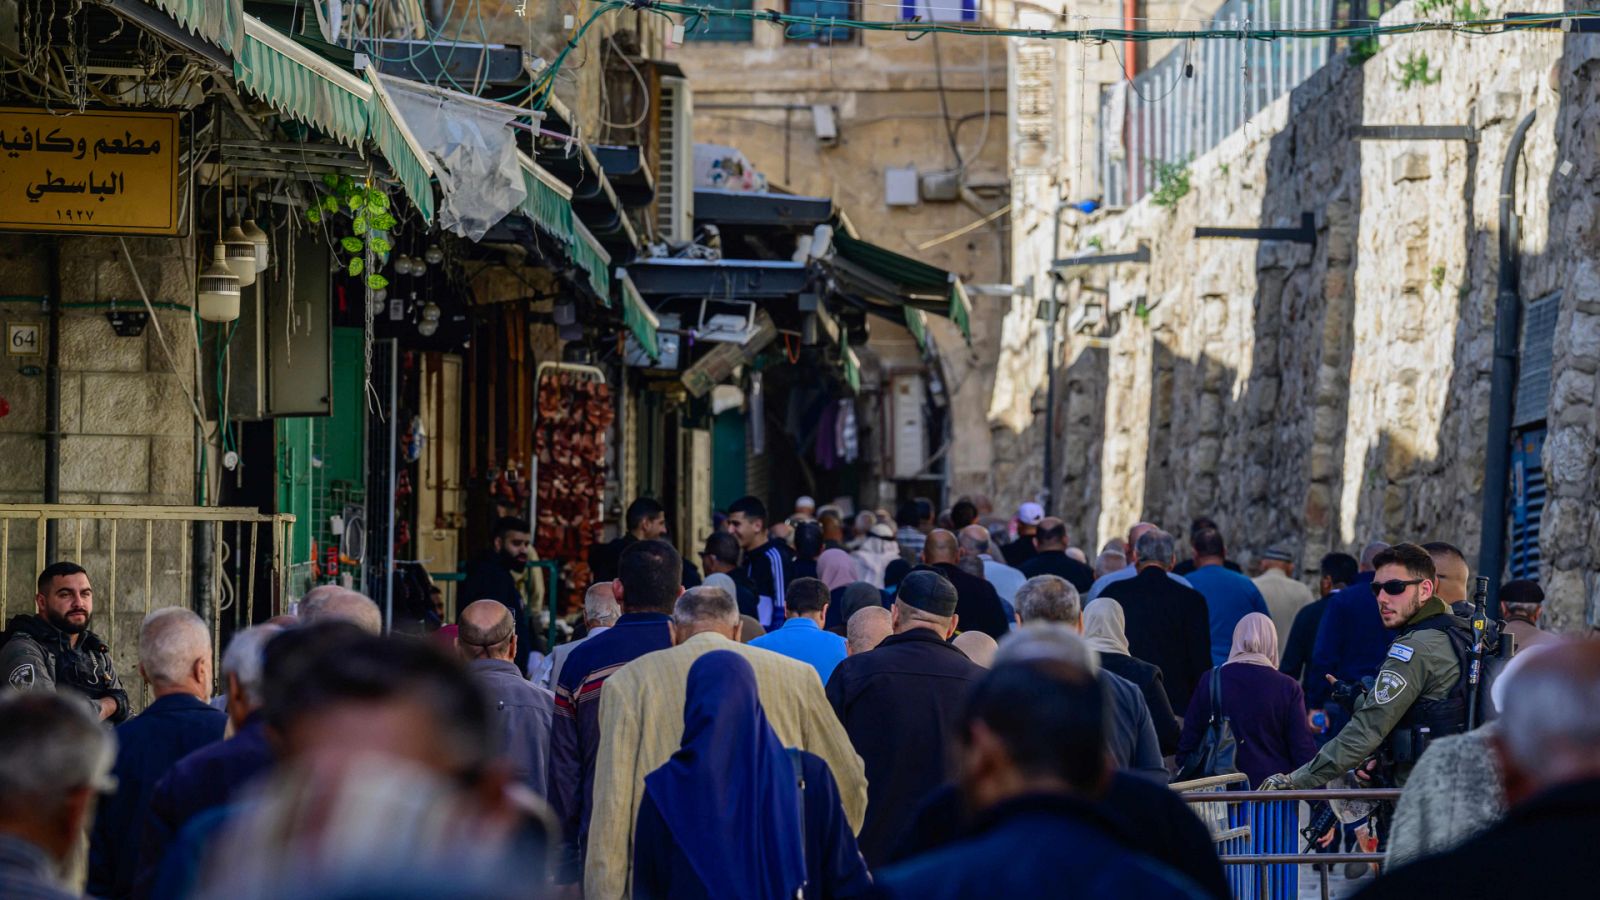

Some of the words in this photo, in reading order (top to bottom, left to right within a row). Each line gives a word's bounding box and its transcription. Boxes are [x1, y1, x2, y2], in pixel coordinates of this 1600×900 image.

[94, 131, 161, 161] مطعم
[26, 169, 124, 203] الباسطي
[57, 210, 95, 221] ١٩٢٧
[12, 330, 36, 347] 64
